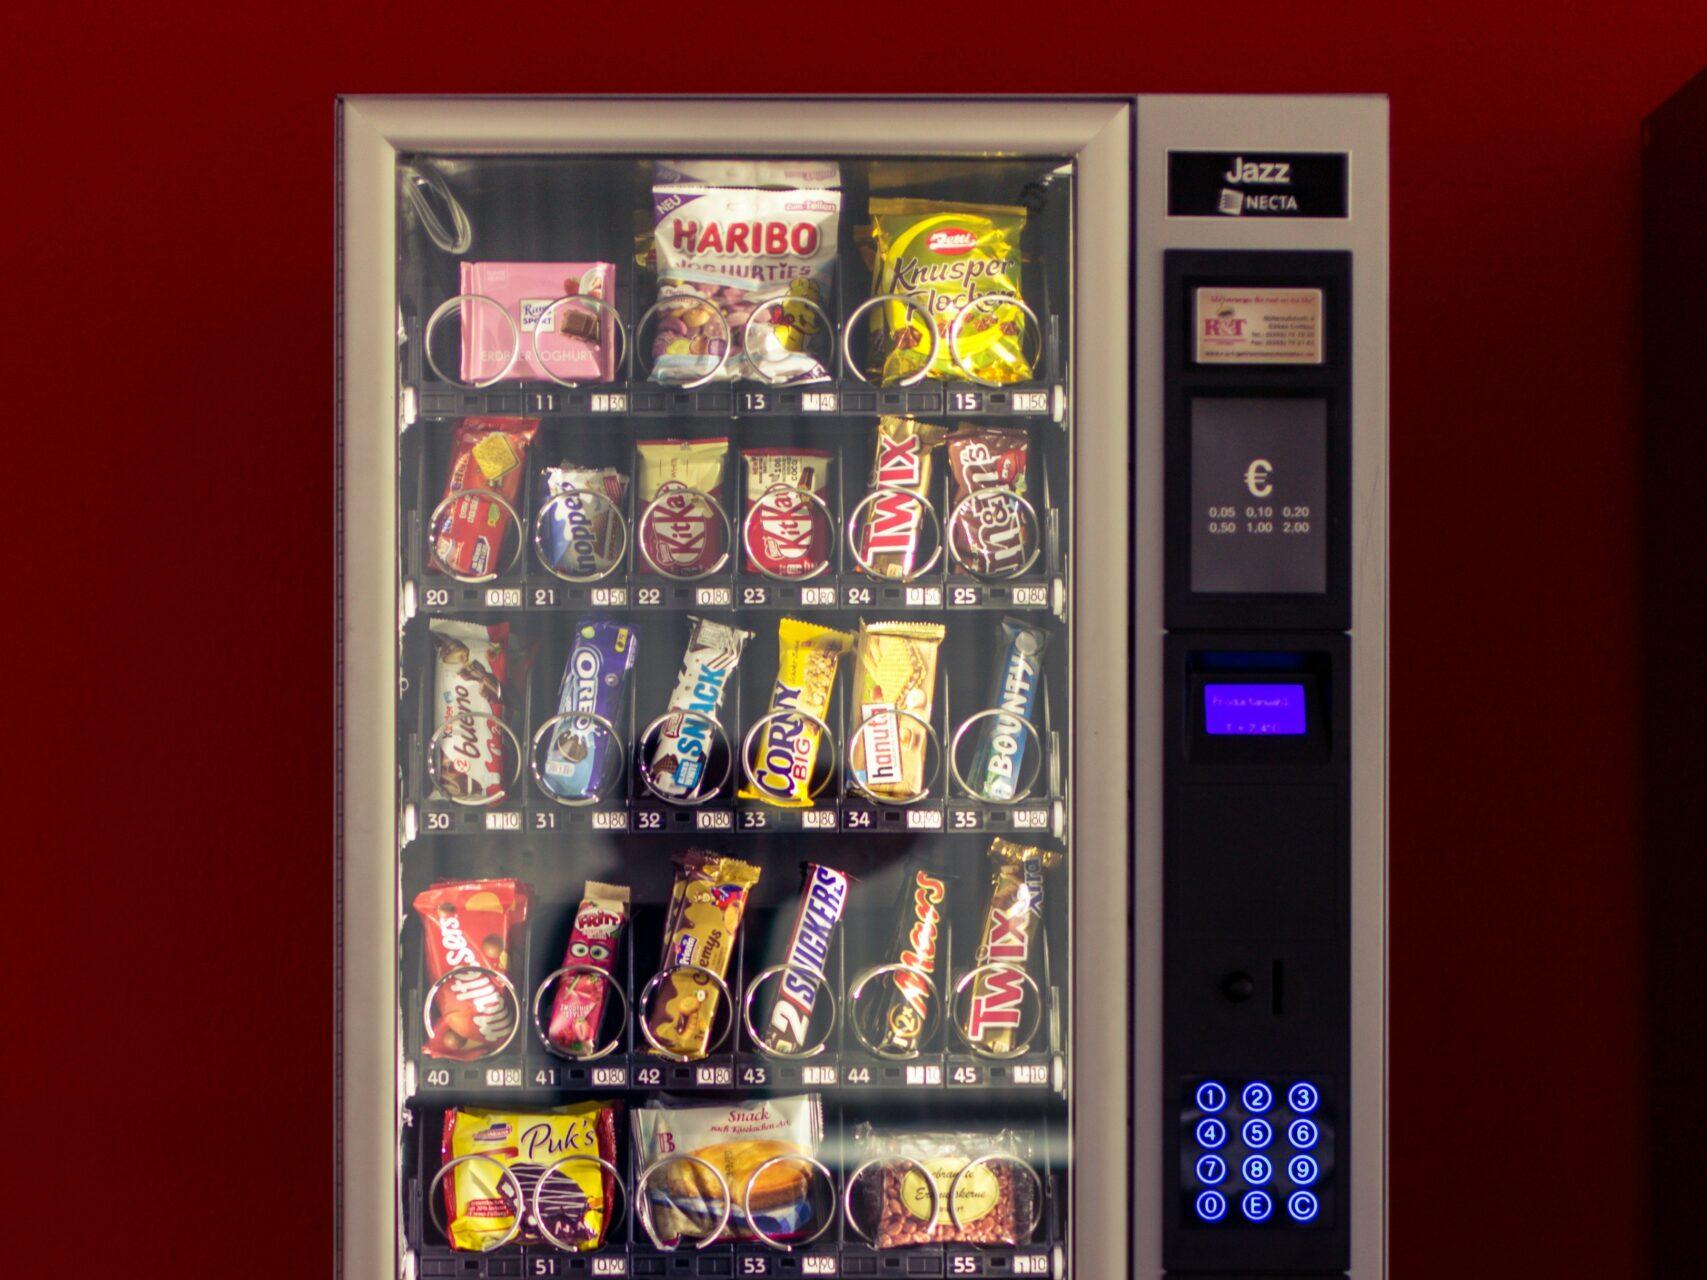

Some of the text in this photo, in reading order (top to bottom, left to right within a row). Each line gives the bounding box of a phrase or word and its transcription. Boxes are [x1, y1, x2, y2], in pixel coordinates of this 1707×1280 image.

[1225, 156, 1291, 184] Jazz
[656, 195, 682, 216] NEU
[1246, 194, 1299, 211] NECTA
[672, 218, 818, 256] HARIBO
[889, 256, 1016, 294] Knusper
[536, 394, 553, 410] 11
[746, 394, 765, 410] 13
[956, 394, 977, 410] 15
[1244, 459, 1273, 498] €
[859, 434, 921, 567] TWIX
[652, 481, 706, 555] KitKa
[426, 589, 448, 605] 20
[535, 589, 554, 605] 21
[638, 588, 660, 605] 22
[744, 588, 766, 604] 23
[848, 588, 871, 604] 24
[954, 588, 976, 604] 25
[573, 648, 600, 731] OREO
[676, 663, 726, 759] SNACK
[987, 655, 1036, 779] BOUNTY
[452, 684, 481, 760] bueno
[755, 680, 804, 795] CORNY
[868, 706, 895, 779] hanuta
[793, 738, 811, 781] BIG
[428, 813, 450, 829] 30
[536, 813, 554, 829] 31
[639, 812, 660, 828] 32
[744, 811, 766, 827] 33
[848, 811, 871, 827] 34
[955, 811, 977, 828] 35
[786, 865, 846, 1006] SNICKERS
[693, 927, 722, 986] Cemys
[968, 907, 1029, 1042] TWIX
[772, 1000, 811, 1047] 2
[427, 1070, 449, 1086] 40
[535, 1069, 554, 1085] 41
[638, 1068, 660, 1084] 42
[744, 1068, 766, 1084] 43
[848, 1068, 870, 1083] 44
[954, 1067, 977, 1083] 45
[1206, 1089, 1215, 1106] 1
[1250, 1089, 1264, 1106] 2
[1297, 1089, 1310, 1106] 3
[728, 1107, 770, 1123] Snack
[520, 1120, 596, 1160] Puk's
[1204, 1125, 1216, 1141] 4
[1250, 1125, 1264, 1141] 5
[1297, 1125, 1310, 1141] 6
[1204, 1161, 1216, 1177] 7
[1250, 1161, 1264, 1177] 8
[1297, 1161, 1310, 1177] 9
[1251, 1197, 1263, 1214] E
[1294, 1197, 1311, 1214] C
[535, 1259, 554, 1275] 51
[744, 1257, 766, 1274] 53
[954, 1256, 976, 1273] 55
